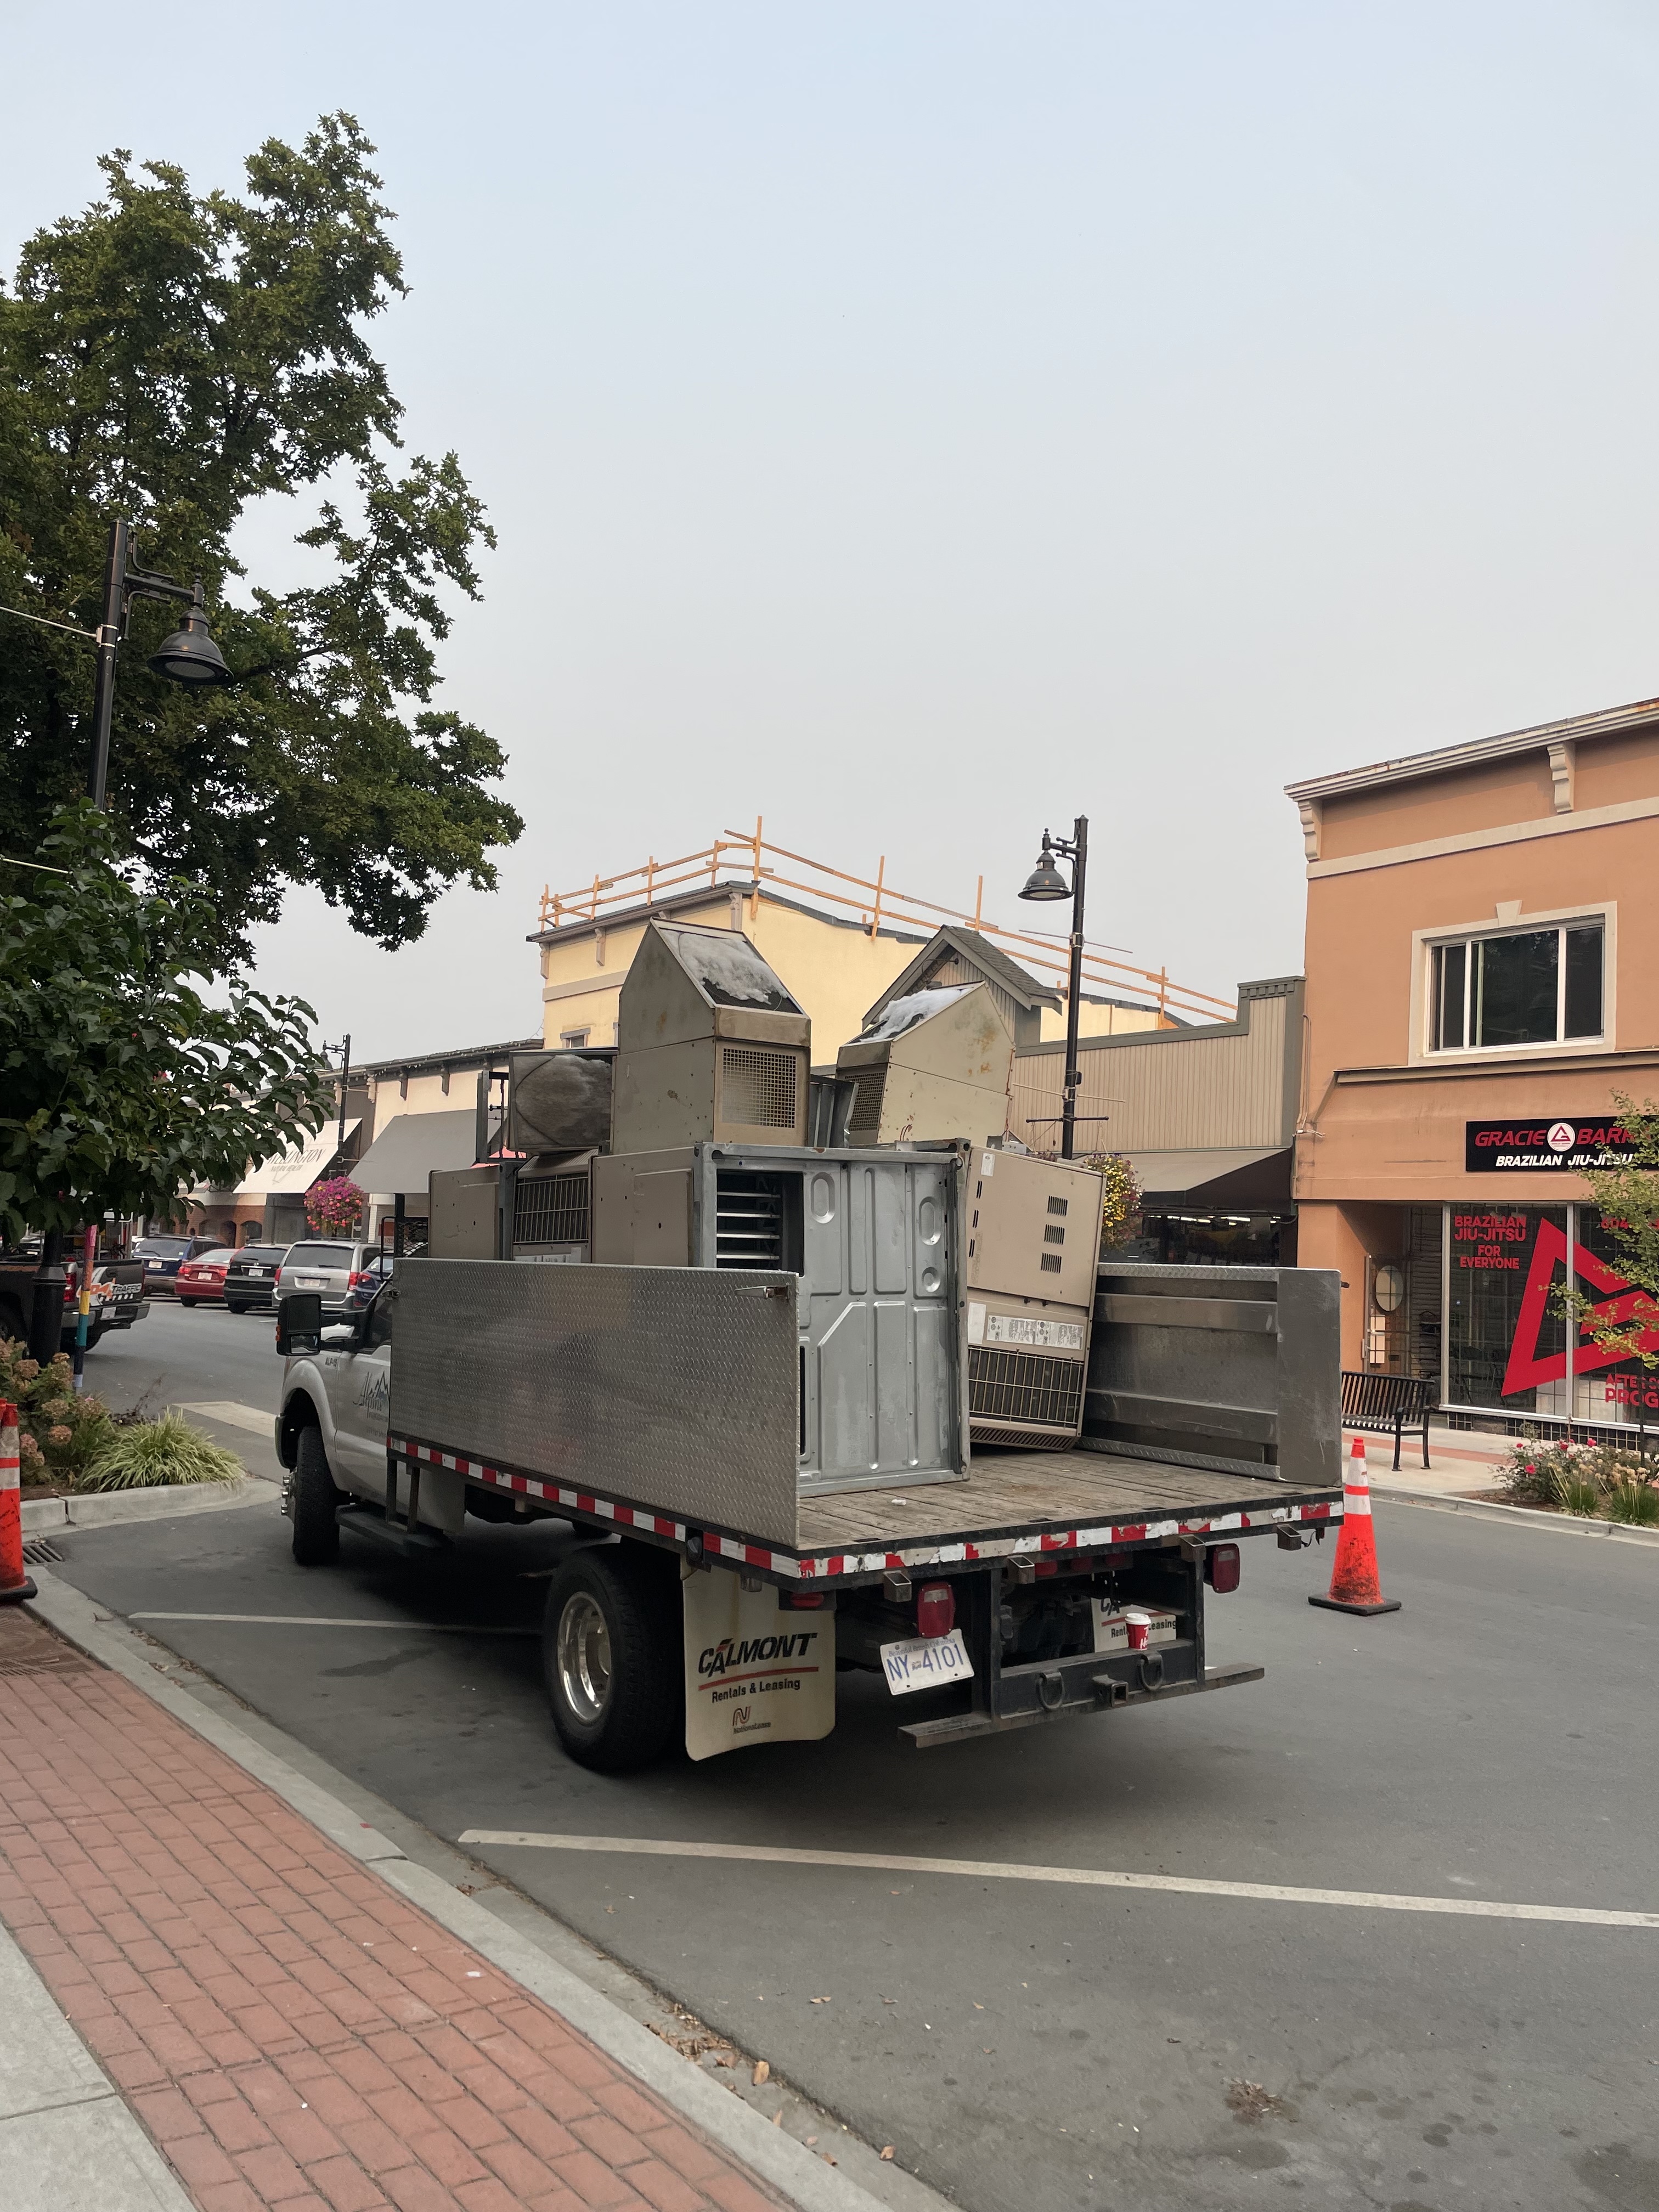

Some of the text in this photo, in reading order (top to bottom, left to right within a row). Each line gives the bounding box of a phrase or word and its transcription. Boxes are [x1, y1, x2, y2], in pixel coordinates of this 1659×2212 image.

[1475, 1129, 1547, 1147] GRACIE
[1496, 1155, 1563, 1166] BRAZILIAN
[1454, 1216, 1526, 1227] BRAZILIAN
[1454, 1228, 1526, 1241] JIU-JITSU
[1477, 1245, 1501, 1256] FOR
[1460, 1256, 1520, 1270] EVERYONE
[352, 1372, 382, 1418] Alpine
[698, 1633, 818, 1678] CALMONT
[887, 1644, 963, 1681] NY 4101
[712, 1678, 800, 1703] Rentals & Leasing
